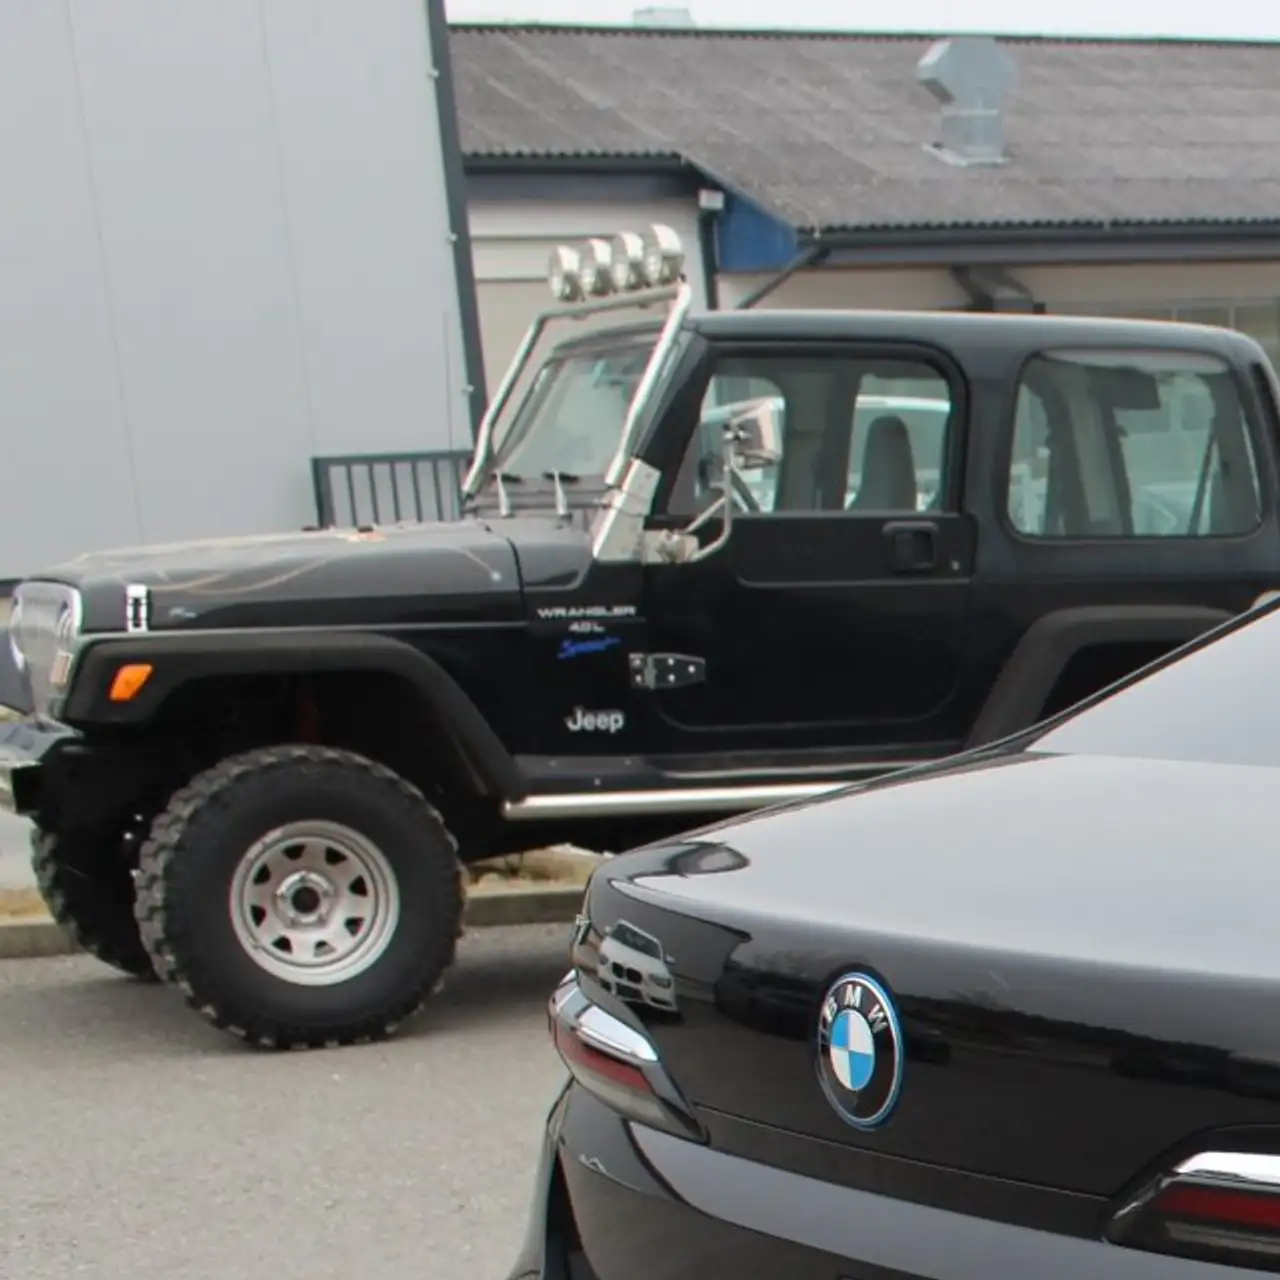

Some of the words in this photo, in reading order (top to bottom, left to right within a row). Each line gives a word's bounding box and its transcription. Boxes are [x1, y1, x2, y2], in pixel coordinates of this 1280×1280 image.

[537, 605, 637, 619] WRANGLER
[564, 704, 625, 733] Jeep
[822, 983, 889, 1034] BMW
